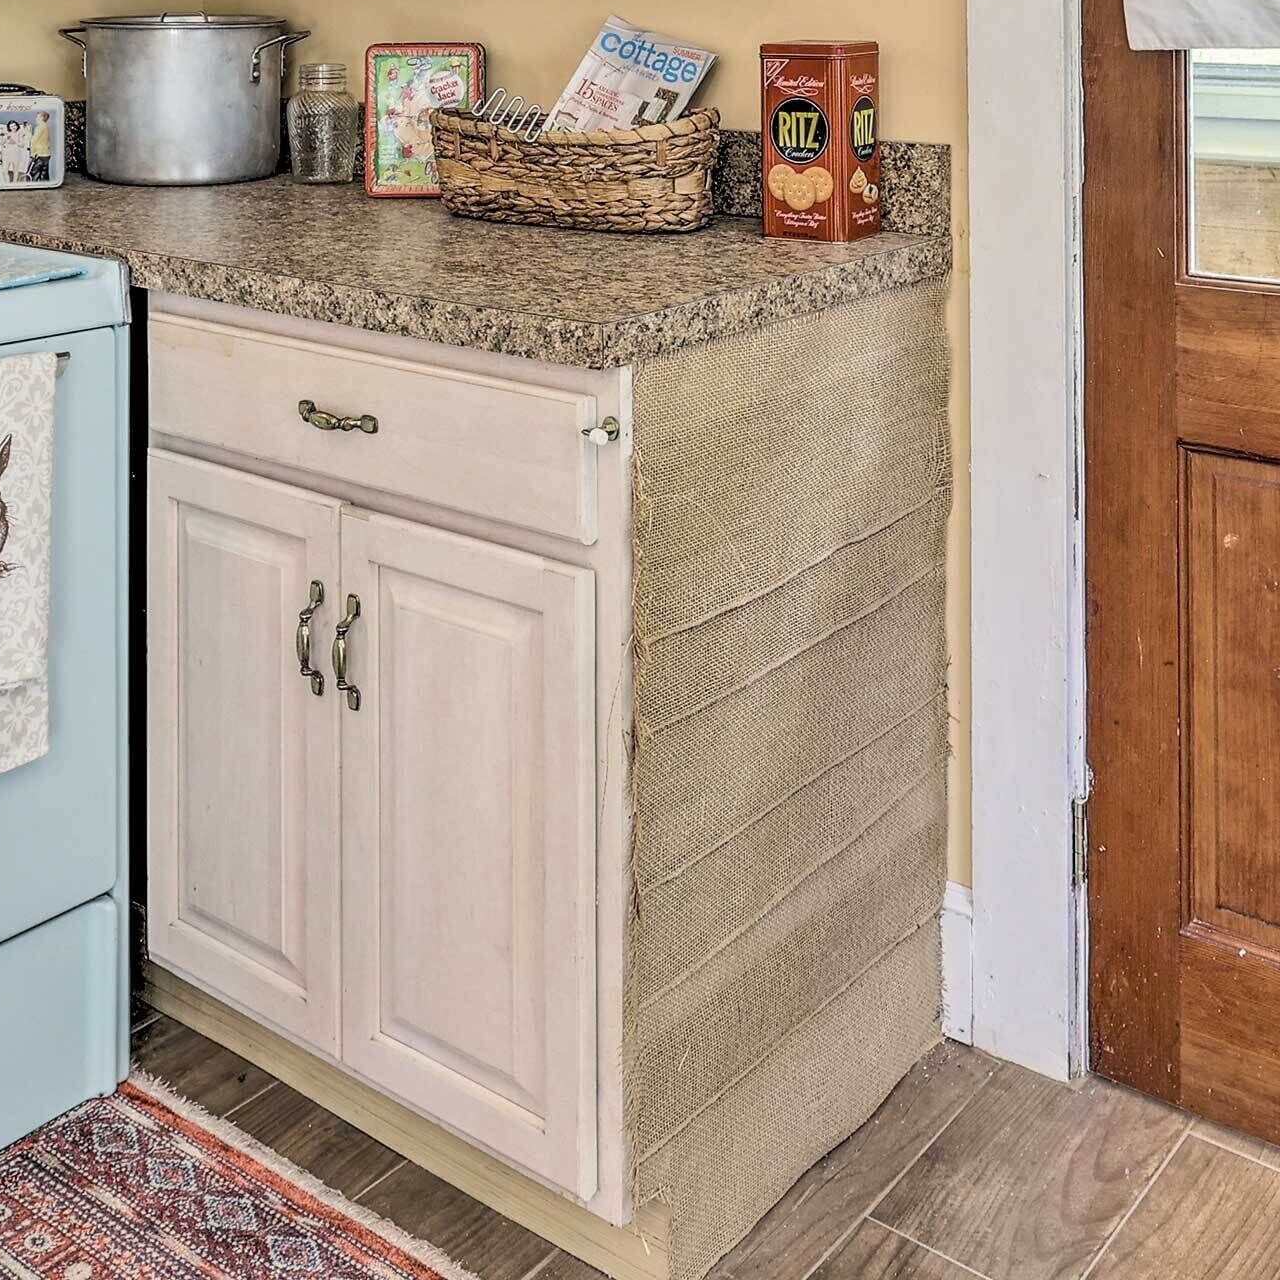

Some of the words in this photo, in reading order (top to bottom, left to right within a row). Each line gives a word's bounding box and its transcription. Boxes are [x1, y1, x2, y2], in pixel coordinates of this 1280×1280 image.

[575, 77, 598, 101] 15
[591, 95, 620, 113] SPACES
[778, 111, 820, 148] RITZ
[853, 108, 875, 148] RITZ
